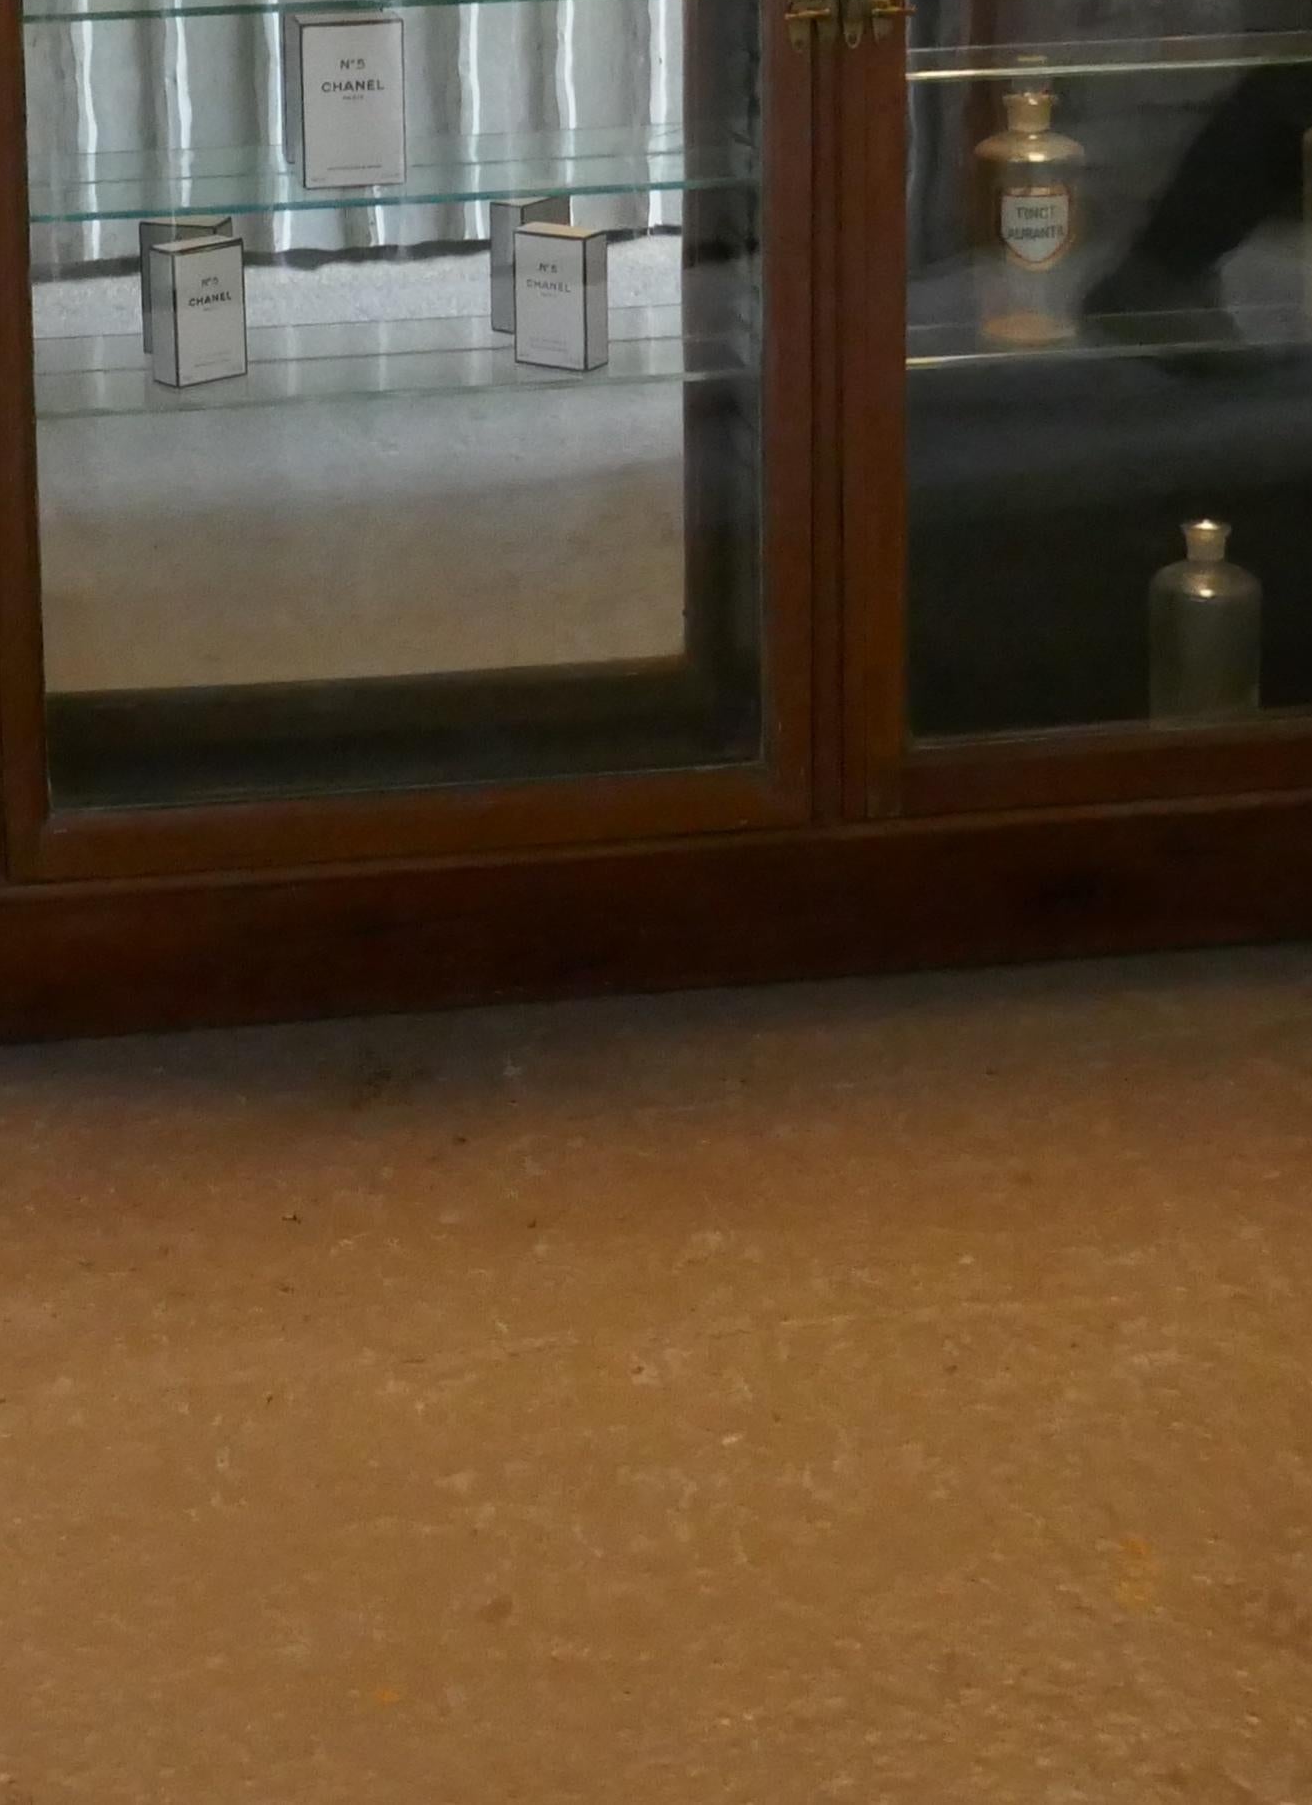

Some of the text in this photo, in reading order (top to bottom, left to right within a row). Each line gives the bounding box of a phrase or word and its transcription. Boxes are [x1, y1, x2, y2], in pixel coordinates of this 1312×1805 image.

[321, 79, 385, 93] CHANEL
[526, 278, 572, 293] CHANEL
[188, 290, 232, 307] CHANEL
